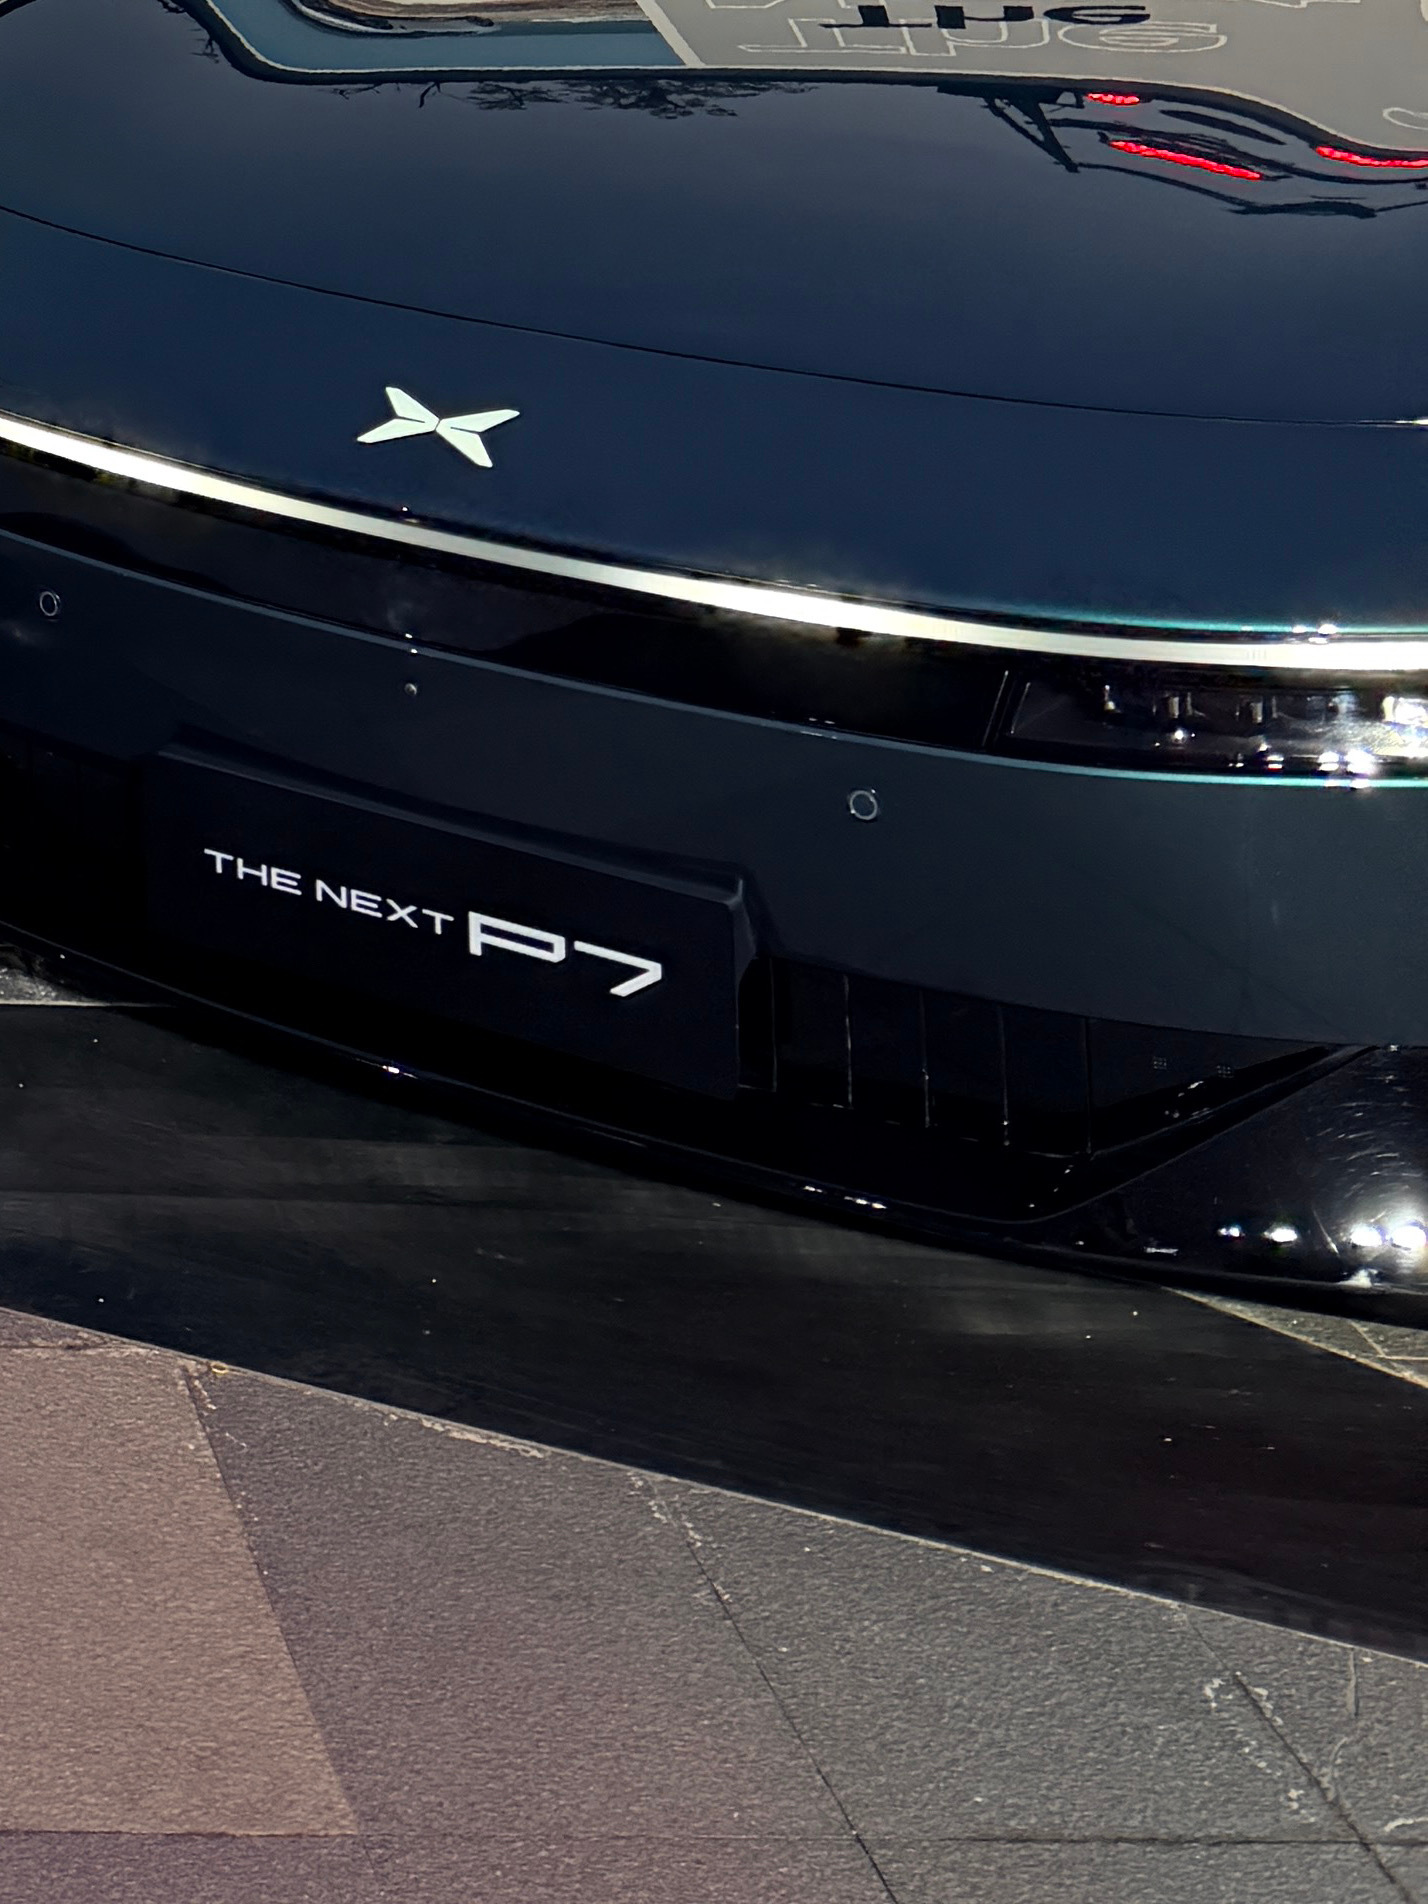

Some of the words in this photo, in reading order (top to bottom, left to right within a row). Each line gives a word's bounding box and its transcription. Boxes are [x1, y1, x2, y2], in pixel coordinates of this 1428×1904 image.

[204, 848, 302, 896] THE
[316, 879, 455, 936] NEXT
[468, 911, 662, 998] P7
